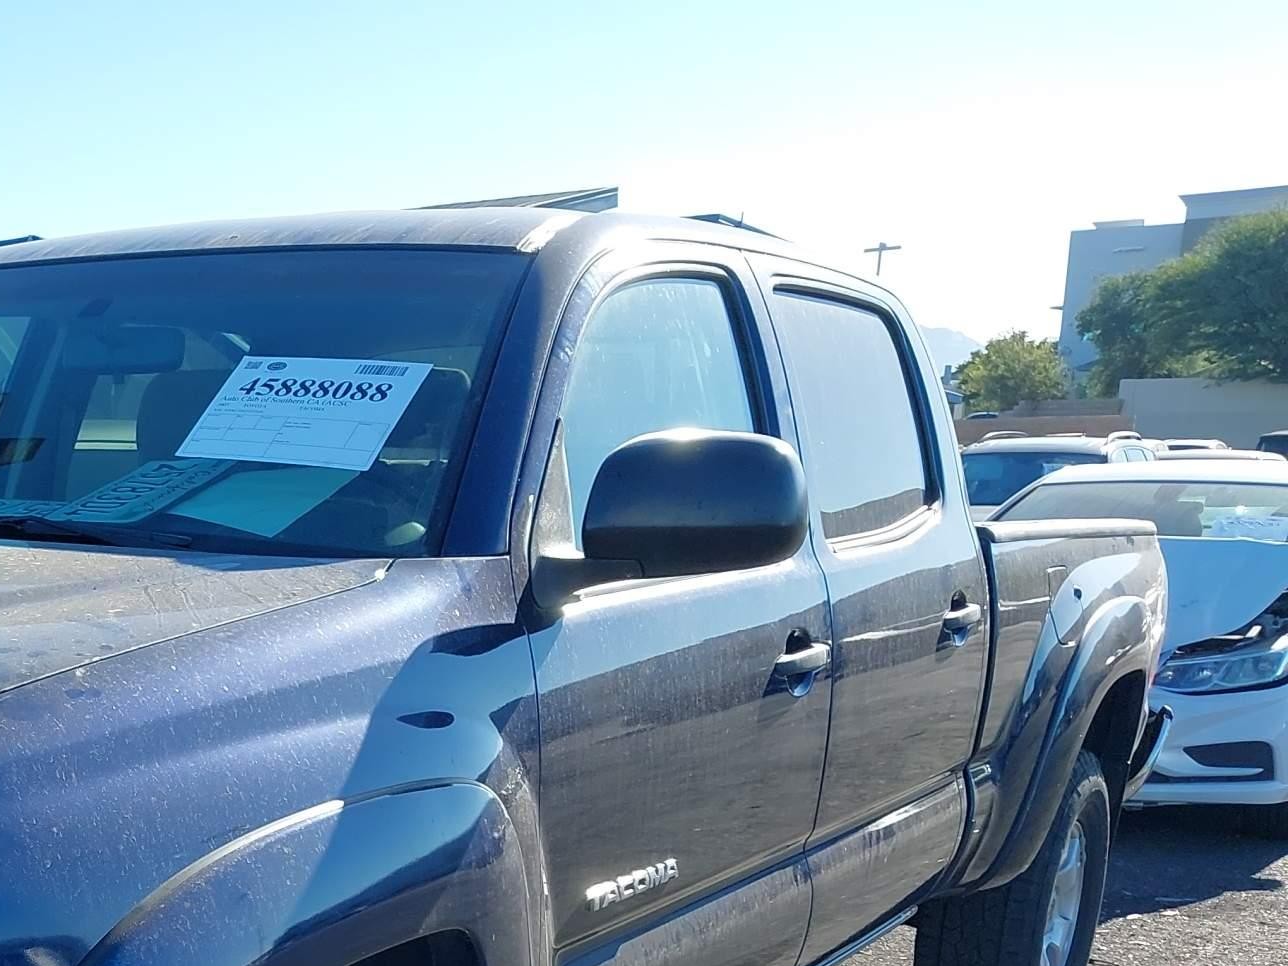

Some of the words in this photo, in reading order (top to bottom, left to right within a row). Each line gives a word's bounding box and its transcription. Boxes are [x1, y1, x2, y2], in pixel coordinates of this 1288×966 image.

[239, 377, 393, 403] 45888088
[271, 397, 305, 406] Southern
[585, 858, 680, 912] TACOMA
